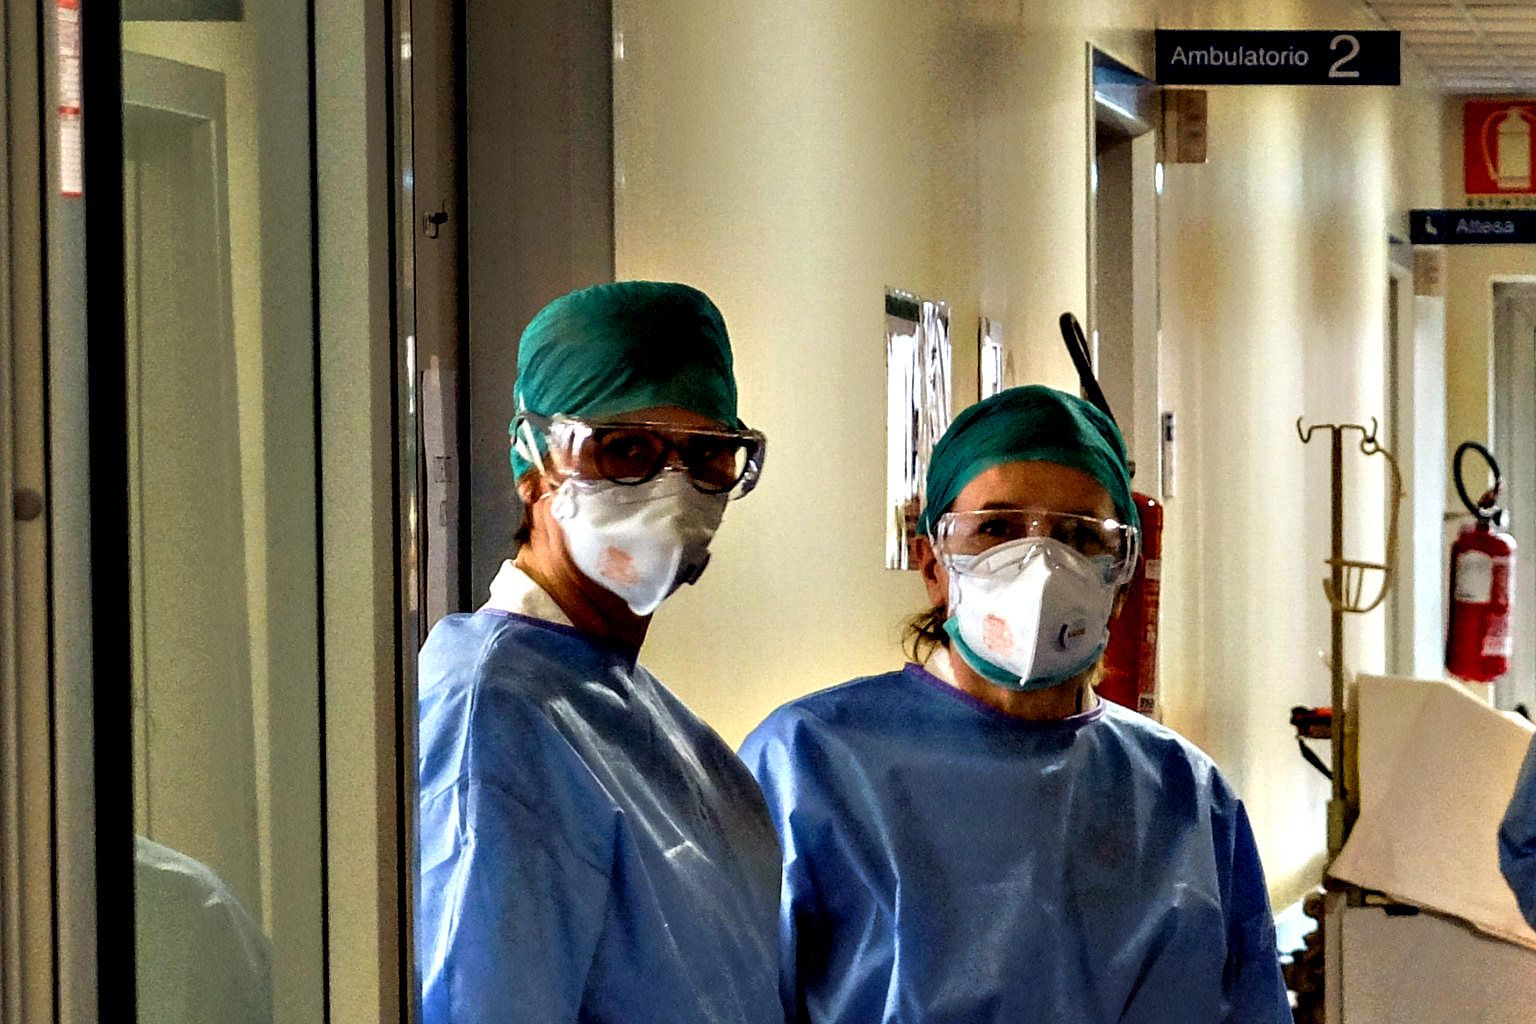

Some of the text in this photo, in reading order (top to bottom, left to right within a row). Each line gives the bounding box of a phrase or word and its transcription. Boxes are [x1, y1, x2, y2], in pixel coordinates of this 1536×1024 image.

[1170, 34, 1361, 78] Ambulatorio 2
[1456, 218, 1515, 235] Attesa
